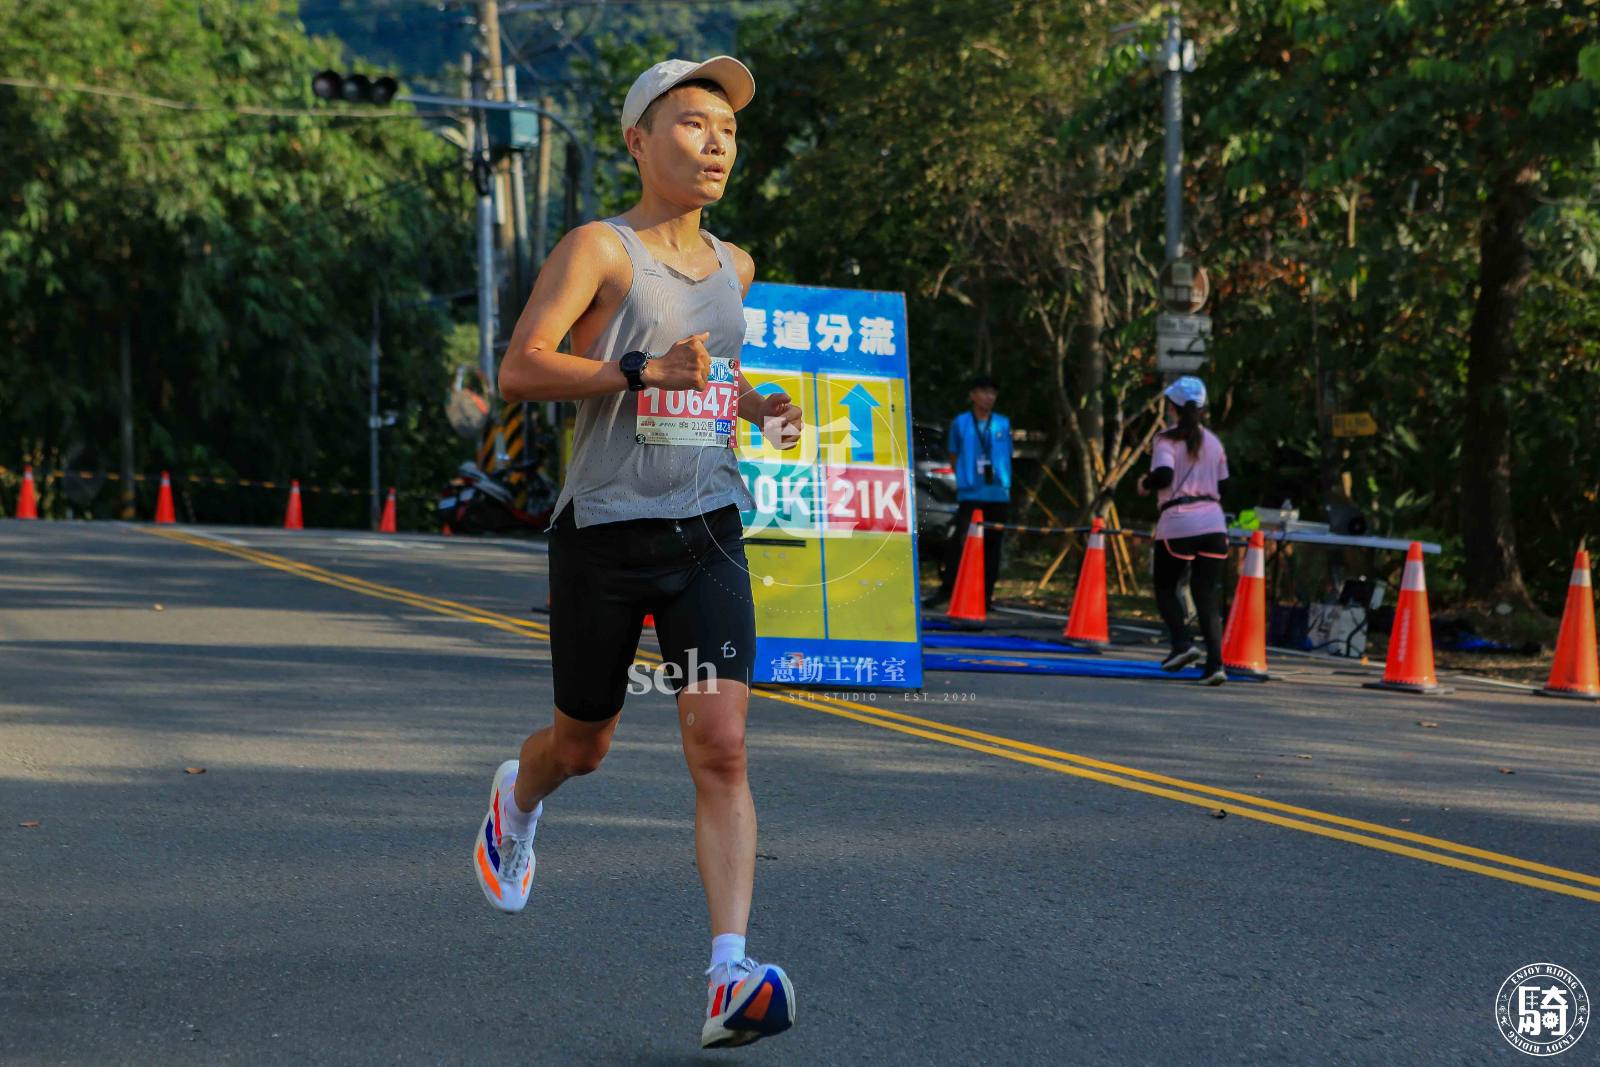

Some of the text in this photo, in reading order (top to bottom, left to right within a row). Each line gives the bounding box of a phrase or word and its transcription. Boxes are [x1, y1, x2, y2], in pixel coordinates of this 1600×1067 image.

[643, 386, 732, 417] 10647
[744, 473, 811, 517] 0K
[831, 479, 904, 521] 21K
